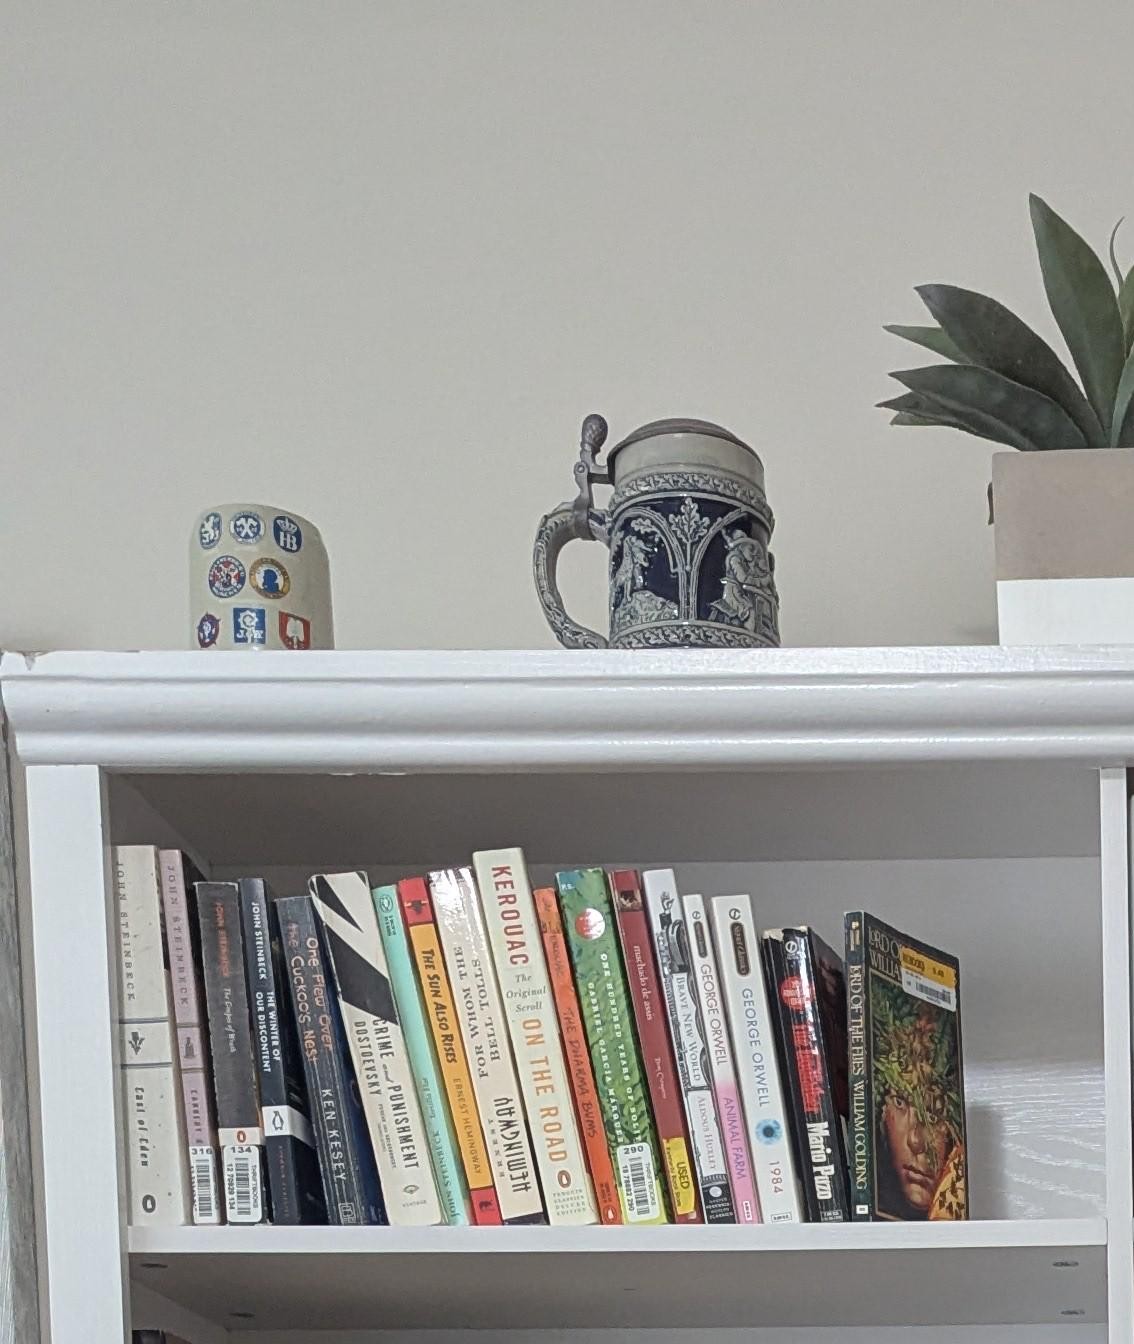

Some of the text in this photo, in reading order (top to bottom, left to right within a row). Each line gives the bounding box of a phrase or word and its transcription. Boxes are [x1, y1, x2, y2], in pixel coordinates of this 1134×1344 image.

[251, 902, 266, 981] JOHN STEINBECK
[491, 865, 529, 965] KEROUAC
[422, 950, 457, 1063] THE SUN ALSO RISES
[505, 986, 546, 1000] Original
[514, 973, 532, 983] The
[515, 1001, 542, 1013] Scroll
[354, 1021, 382, 1095] DOSTOEVSKY
[742, 987, 769, 1108] GEORGE ORWELL
[374, 1018, 394, 1060] CRIME
[390, 1086, 420, 1170] PUNISHMENT
[522, 1018, 568, 1163] ON THE ROAD
[723, 1097, 746, 1181] ANIMAL FARM
[768, 1160, 783, 1195] 1984
